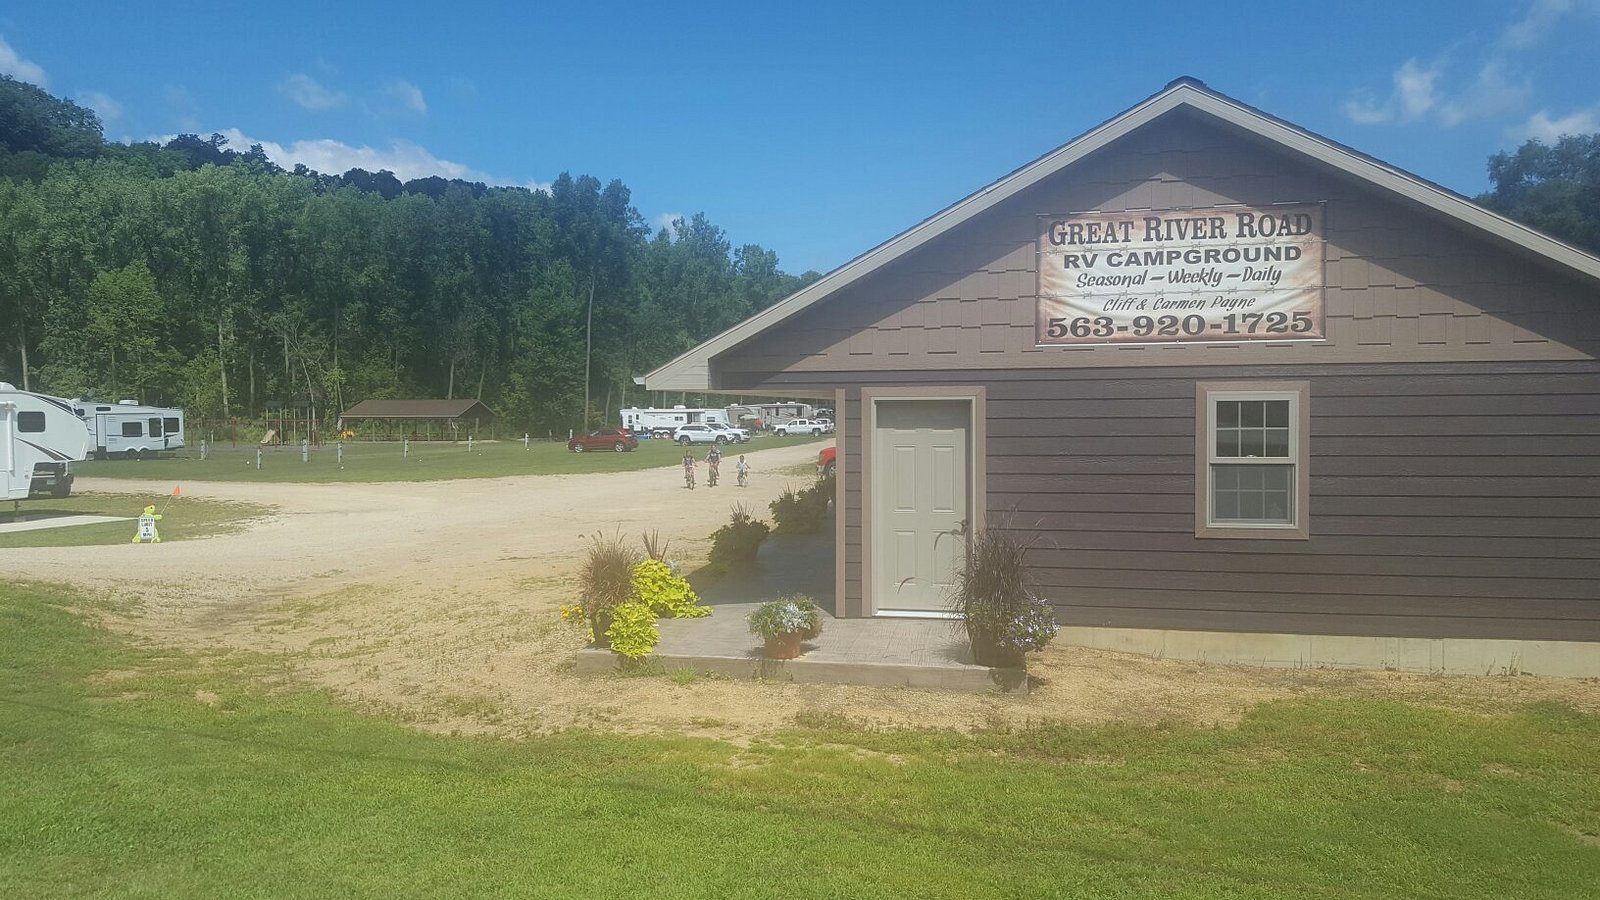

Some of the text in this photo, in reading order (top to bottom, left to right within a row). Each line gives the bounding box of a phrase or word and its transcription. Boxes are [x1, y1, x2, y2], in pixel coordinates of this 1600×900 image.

[1048, 212, 1313, 246] GREAT RIVER ROAD
[1064, 246, 1302, 269] RV CAMPGROUND
[1076, 269, 1148, 288] Seasonal
[1168, 268, 1223, 287] Weekly
[1242, 266, 1282, 285] Daily
[1102, 296, 1256, 312] Cliff & Carmen Payne
[1047, 312, 1314, 338] 563-920-1725
